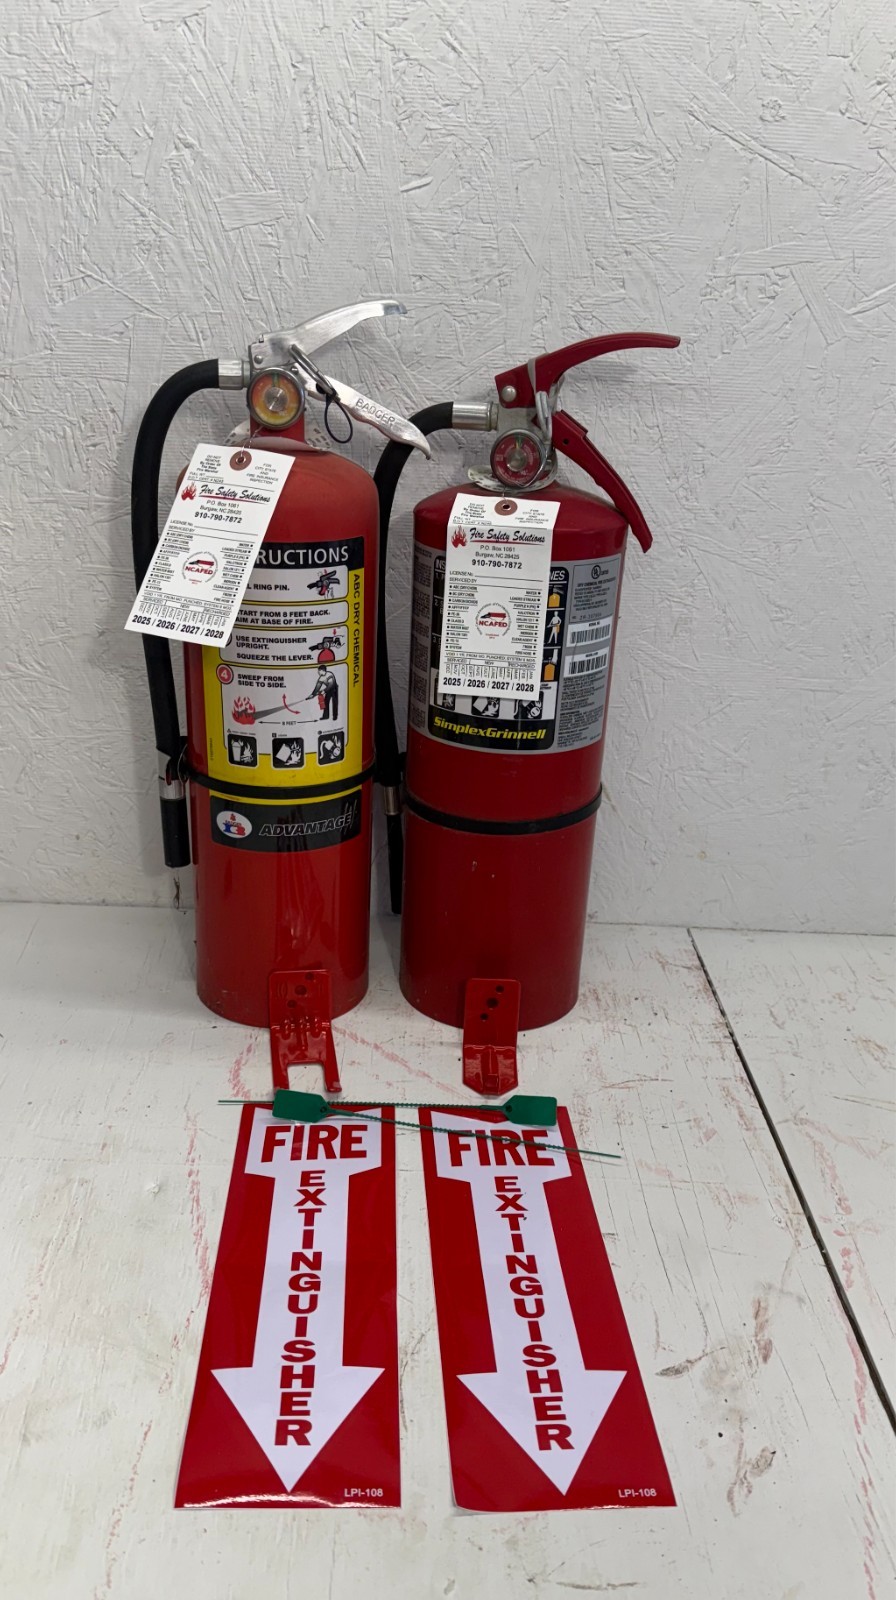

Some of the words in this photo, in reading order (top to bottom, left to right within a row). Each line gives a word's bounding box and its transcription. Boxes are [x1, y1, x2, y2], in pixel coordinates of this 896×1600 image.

[356, 398, 396, 427] BADGER
[198, 483, 215, 496] Fire
[214, 486, 239, 500] Safety
[238, 489, 272, 502] Solutions
[194, 511, 242, 524] 910-790-7872
[468, 527, 484, 540] Fire
[486, 528, 510, 542] Safety
[512, 530, 545, 543] Solutions
[256, 546, 349, 565] RUCTIONS
[471, 558, 522, 569] 910-790-7872
[184, 565, 213, 575] NCAFED
[131, 614, 151, 625] 2025
[155, 619, 176, 629] 2026
[180, 624, 200, 634] 2027
[204, 628, 224, 639] 2028
[221, 670, 228, 679] 4
[443, 677, 461, 686] 2025
[467, 679, 485, 687] 2026
[491, 681, 509, 690] 2027
[515, 683, 534, 692] 2028
[434, 716, 546, 739] SimplexGrinnell
[259, 813, 351, 836] ADVANTAGE
[261, 1124, 368, 1163] FIRE
[448, 1130, 555, 1166] FIRE
[274, 1170, 327, 1446] EXTINGUISHER
[494, 1176, 575, 1451] EXTINGUISHER
[344, 1488, 383, 1498] LPI-108
[618, 1489, 657, 1498] LPI-108
